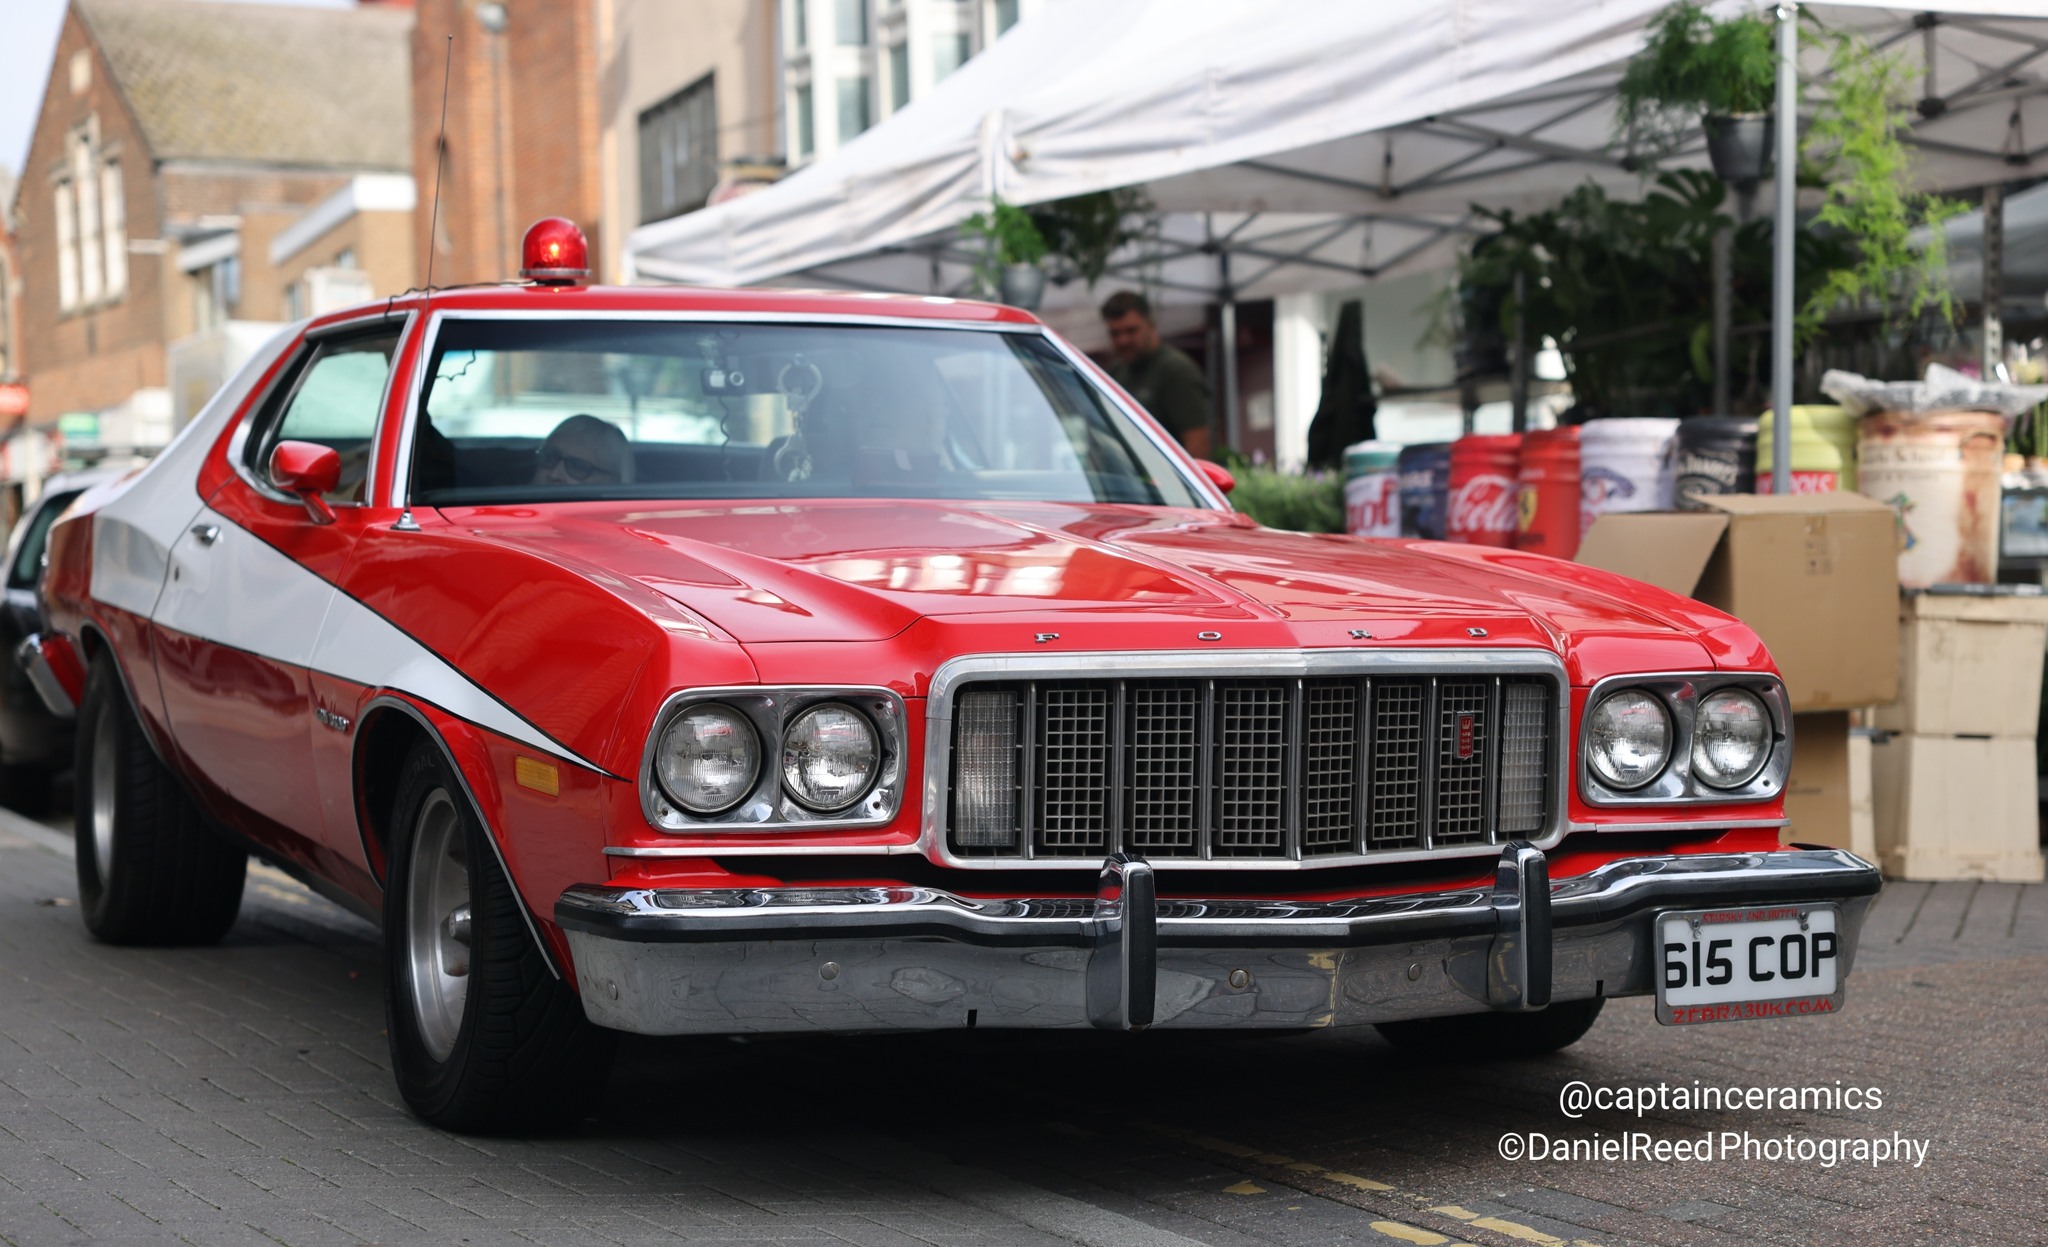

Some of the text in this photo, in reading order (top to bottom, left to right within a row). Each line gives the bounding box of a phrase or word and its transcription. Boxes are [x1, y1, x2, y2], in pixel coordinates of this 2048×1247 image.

[1703, 907, 1798, 925] STARSKY AND HUTCH
[1664, 932, 1837, 989] 615 COP
